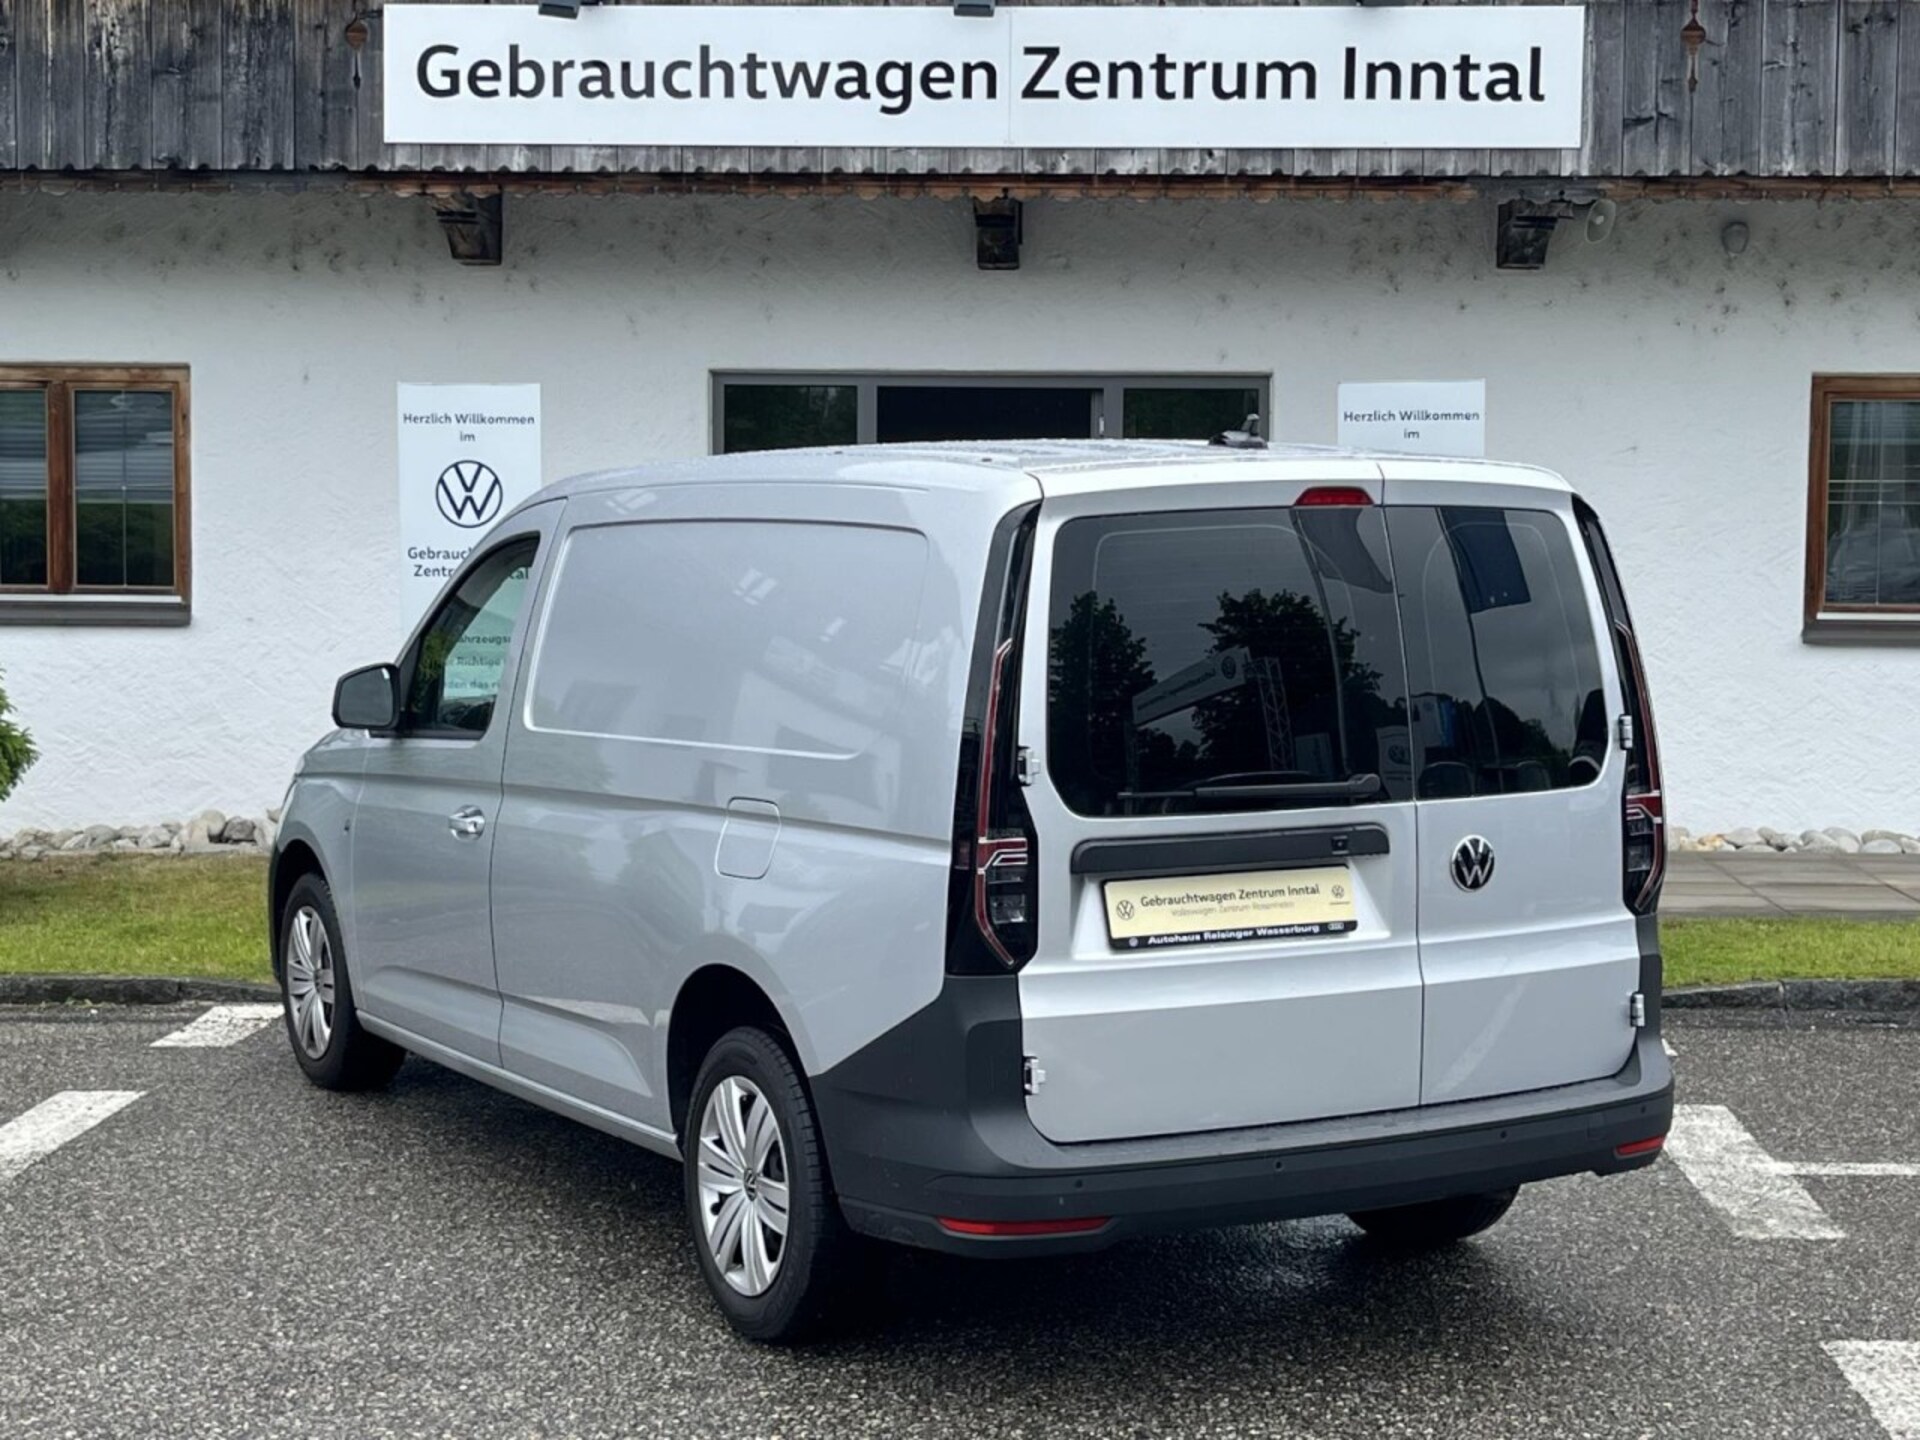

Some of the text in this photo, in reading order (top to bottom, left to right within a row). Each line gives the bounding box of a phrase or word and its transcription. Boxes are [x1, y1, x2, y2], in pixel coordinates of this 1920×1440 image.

[416, 44, 1544, 116] Gebrauchtwagen Zentrum Inntal
[403, 413, 535, 425] Herzlich Willkommen
[1344, 410, 1480, 422] Herzlich Willkommen
[460, 431, 475, 442] im
[1403, 428, 1420, 439] im
[436, 460, 503, 528] VW
[407, 546, 472, 560] Gebrauc
[413, 564, 455, 577] Zentr
[1449, 834, 1495, 893] VW
[1140, 884, 1320, 908] Gebrauchtwagen Zentrum Inntal
[1147, 923, 1320, 946] Autohaus Reisinger Wasserburg
